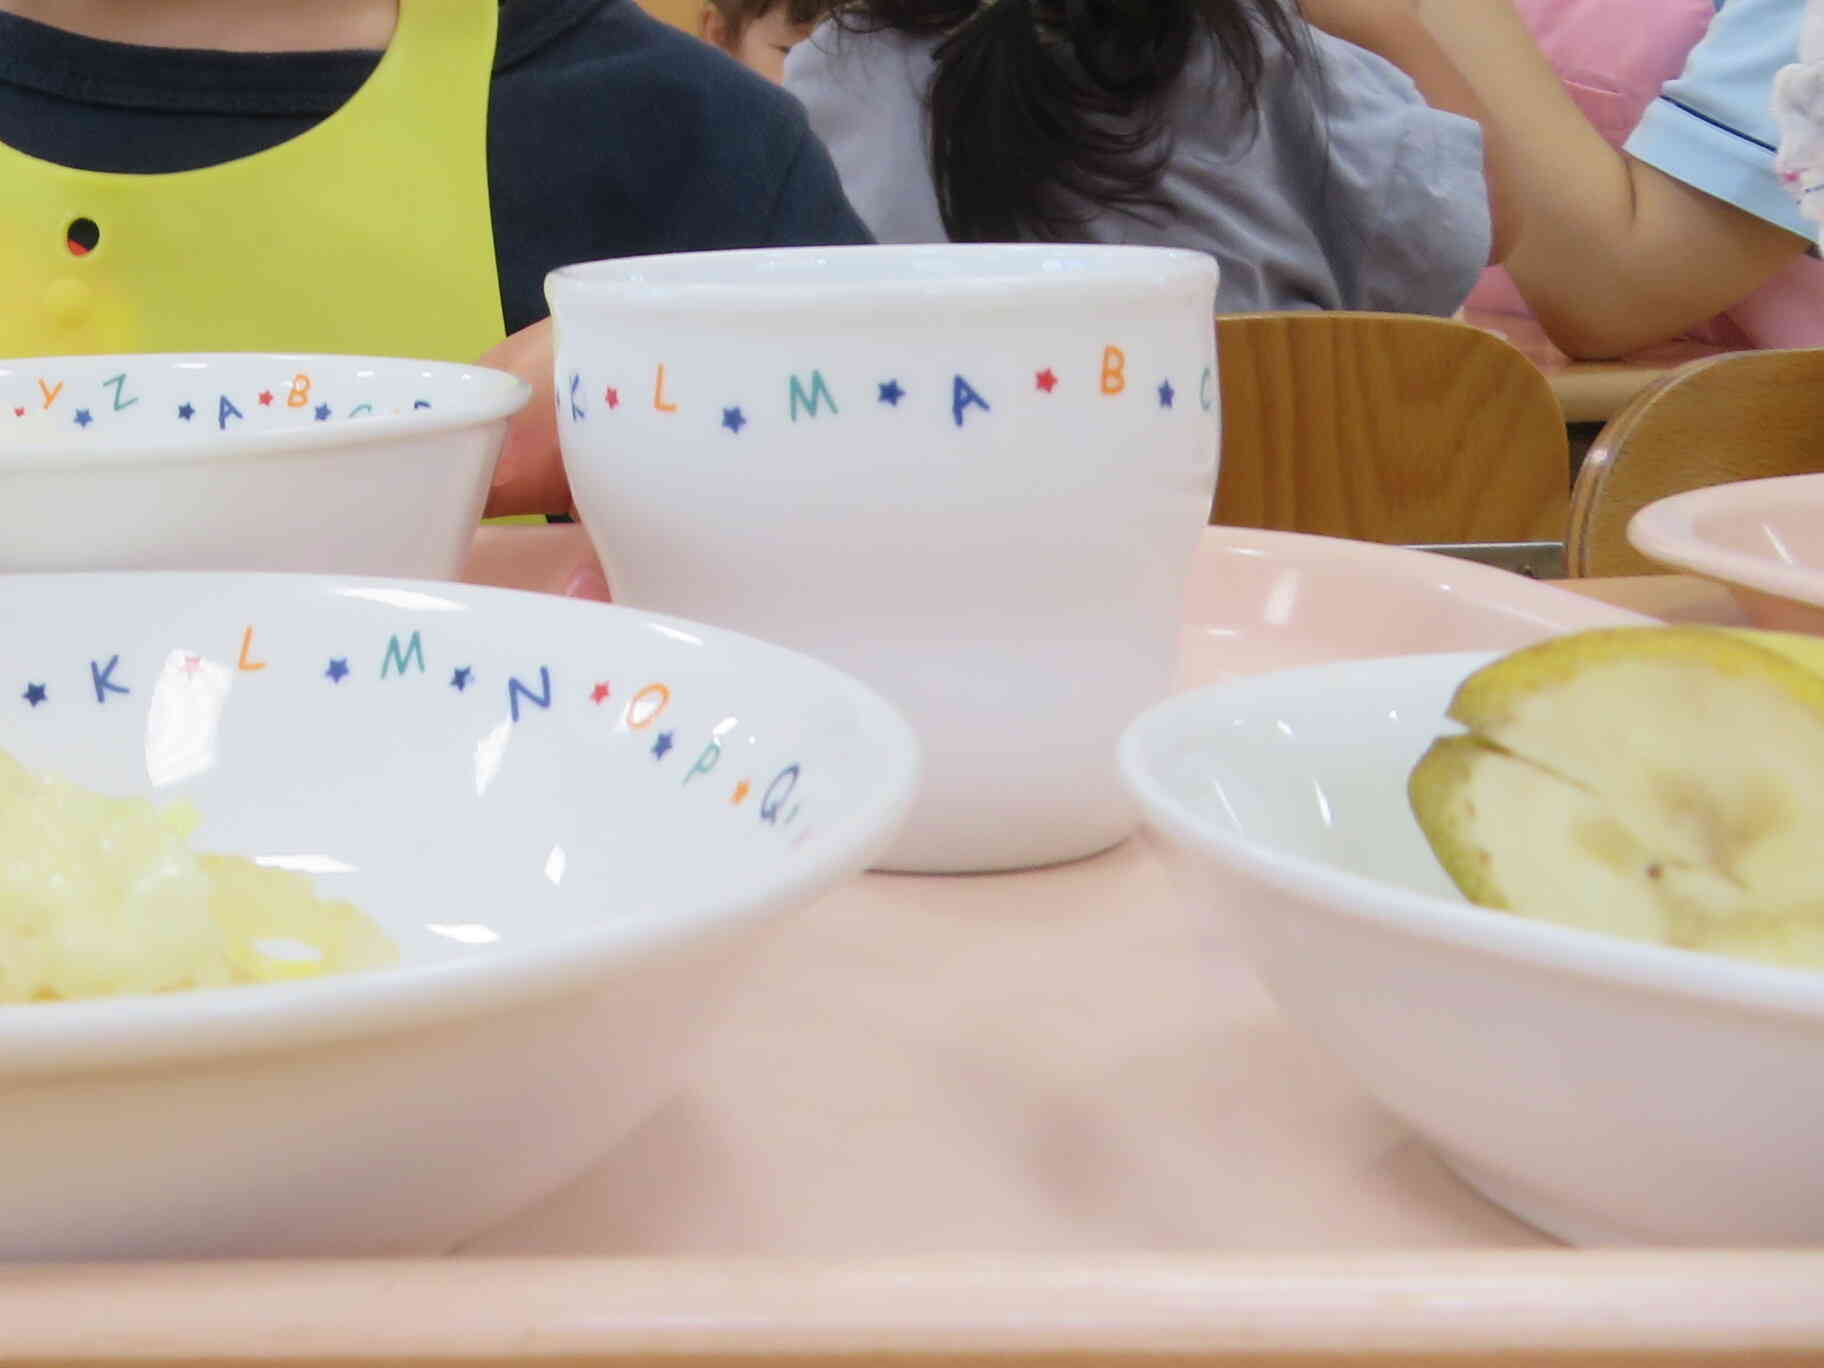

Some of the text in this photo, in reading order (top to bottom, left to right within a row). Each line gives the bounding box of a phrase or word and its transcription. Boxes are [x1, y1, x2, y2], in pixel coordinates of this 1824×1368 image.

[38, 378, 64, 410] Y
[101, 373, 139, 412] Z
[218, 395, 244, 430] A
[287, 373, 312, 409] B
[653, 364, 677, 413] L
[789, 370, 839, 422] M
[953, 374, 992, 428] A
[1100, 345, 1126, 395] B
[89, 653, 131, 705] K
[237, 625, 268, 672] L
[380, 629, 426, 681] M
[507, 665, 553, 723] N
[625, 681, 671, 731] O
